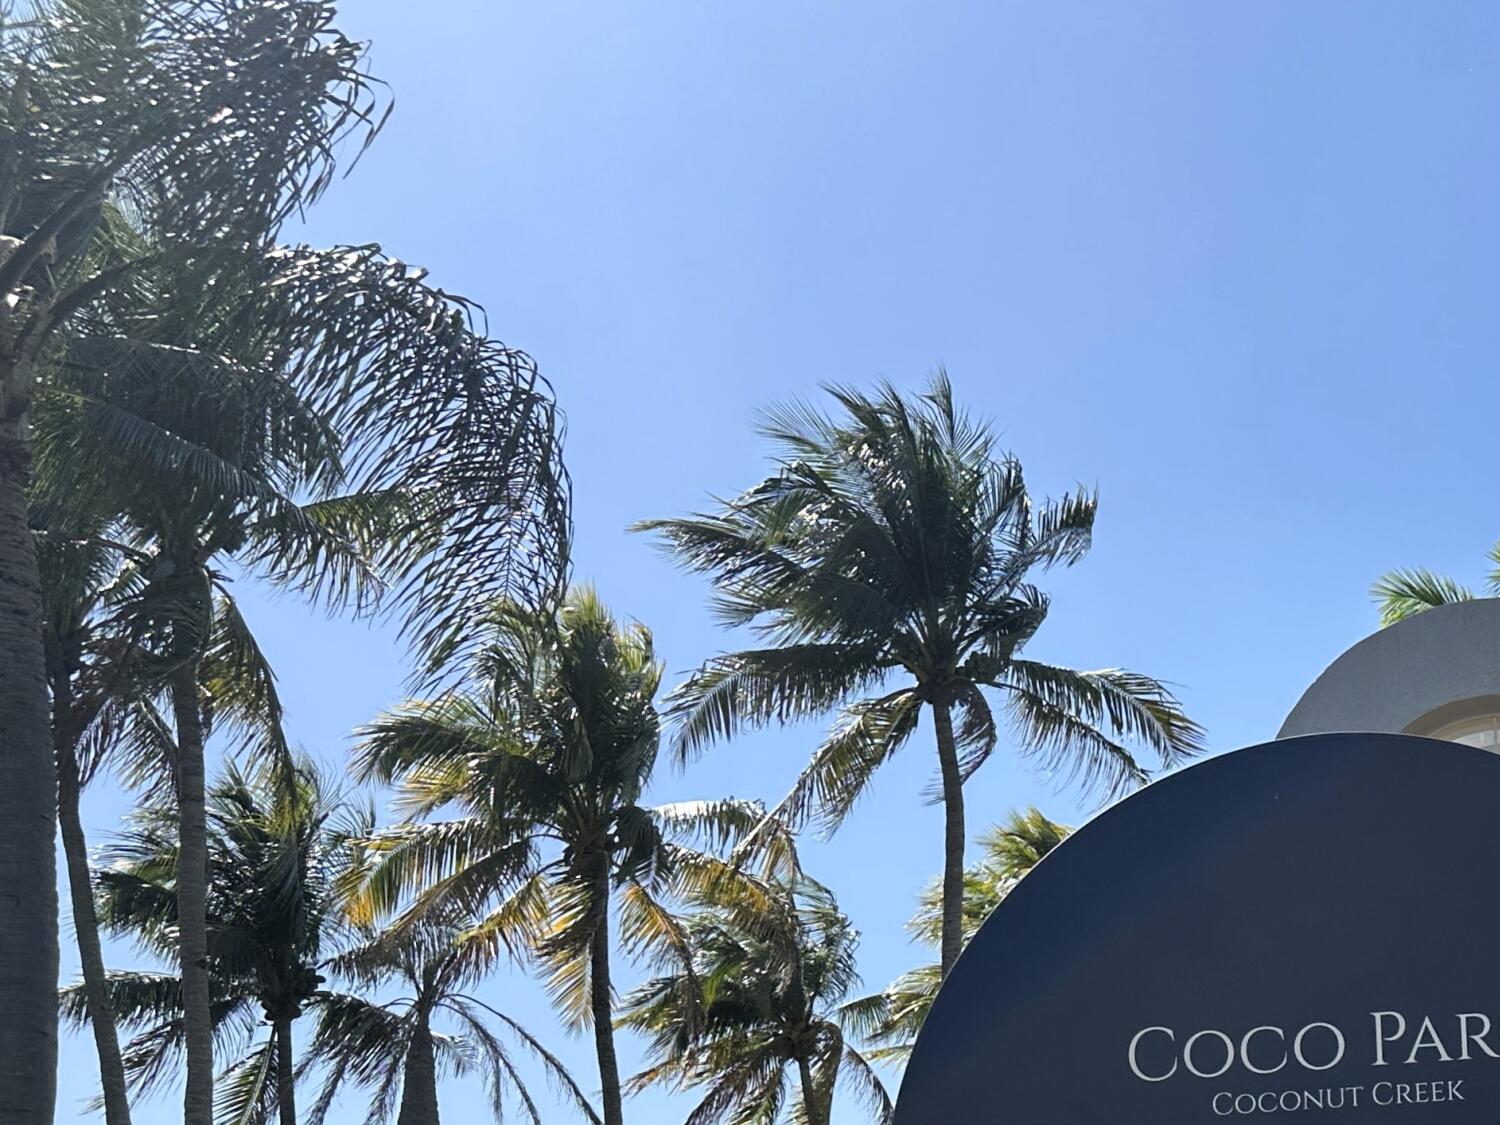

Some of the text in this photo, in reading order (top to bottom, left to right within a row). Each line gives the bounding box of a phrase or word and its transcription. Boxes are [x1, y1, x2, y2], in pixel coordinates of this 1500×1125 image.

[1127, 1022, 1347, 1082] COCO
[1212, 1079, 1465, 1116] COCONUT CREEK
